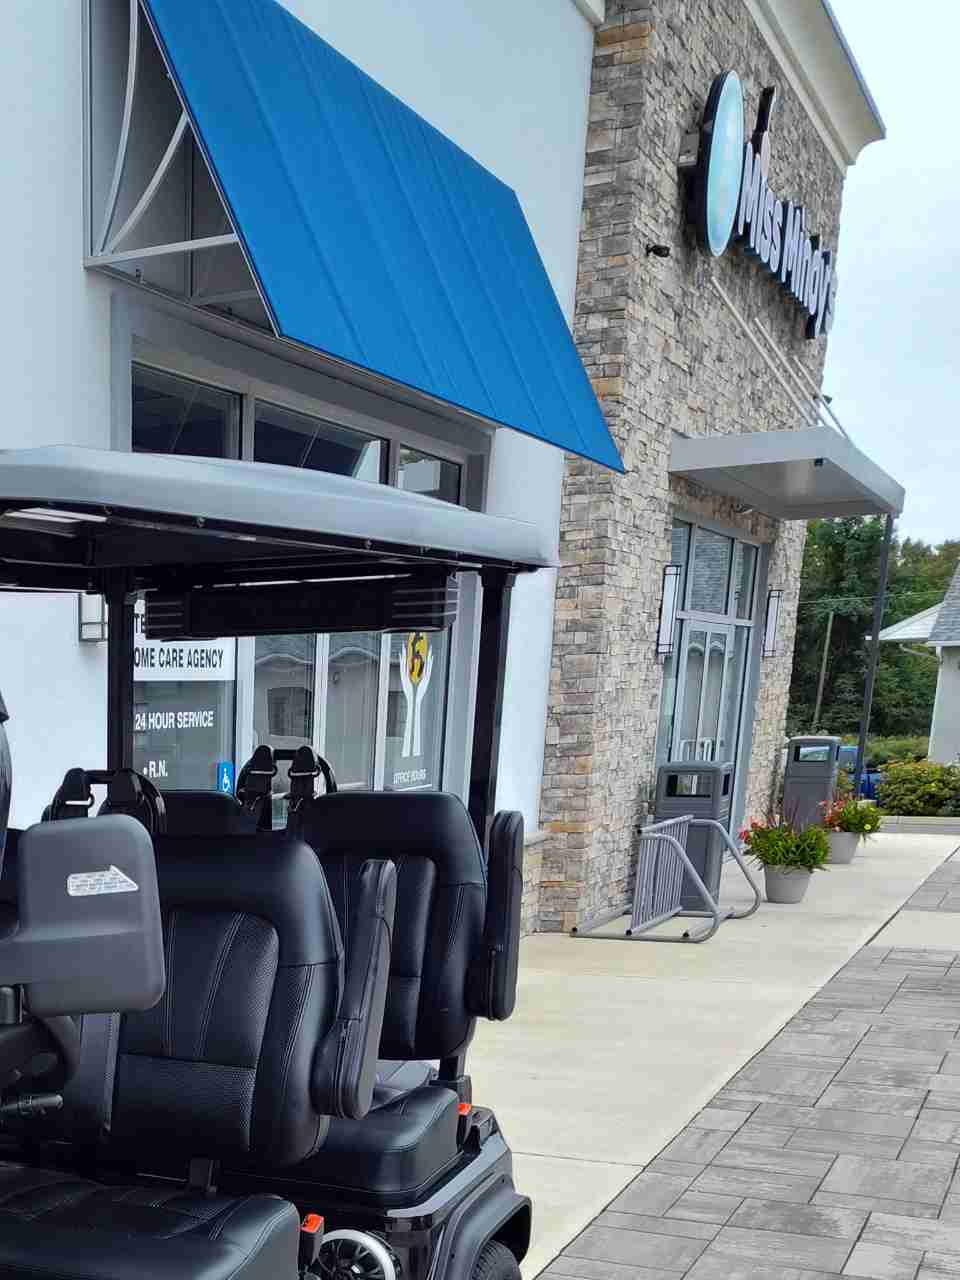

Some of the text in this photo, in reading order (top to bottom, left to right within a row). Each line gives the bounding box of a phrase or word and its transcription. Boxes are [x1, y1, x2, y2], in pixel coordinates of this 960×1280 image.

[737, 133, 783, 273] Miss
[134, 646, 224, 669] OME CARE AGENCY
[135, 710, 214, 731] 24 HOUR SERVICE
